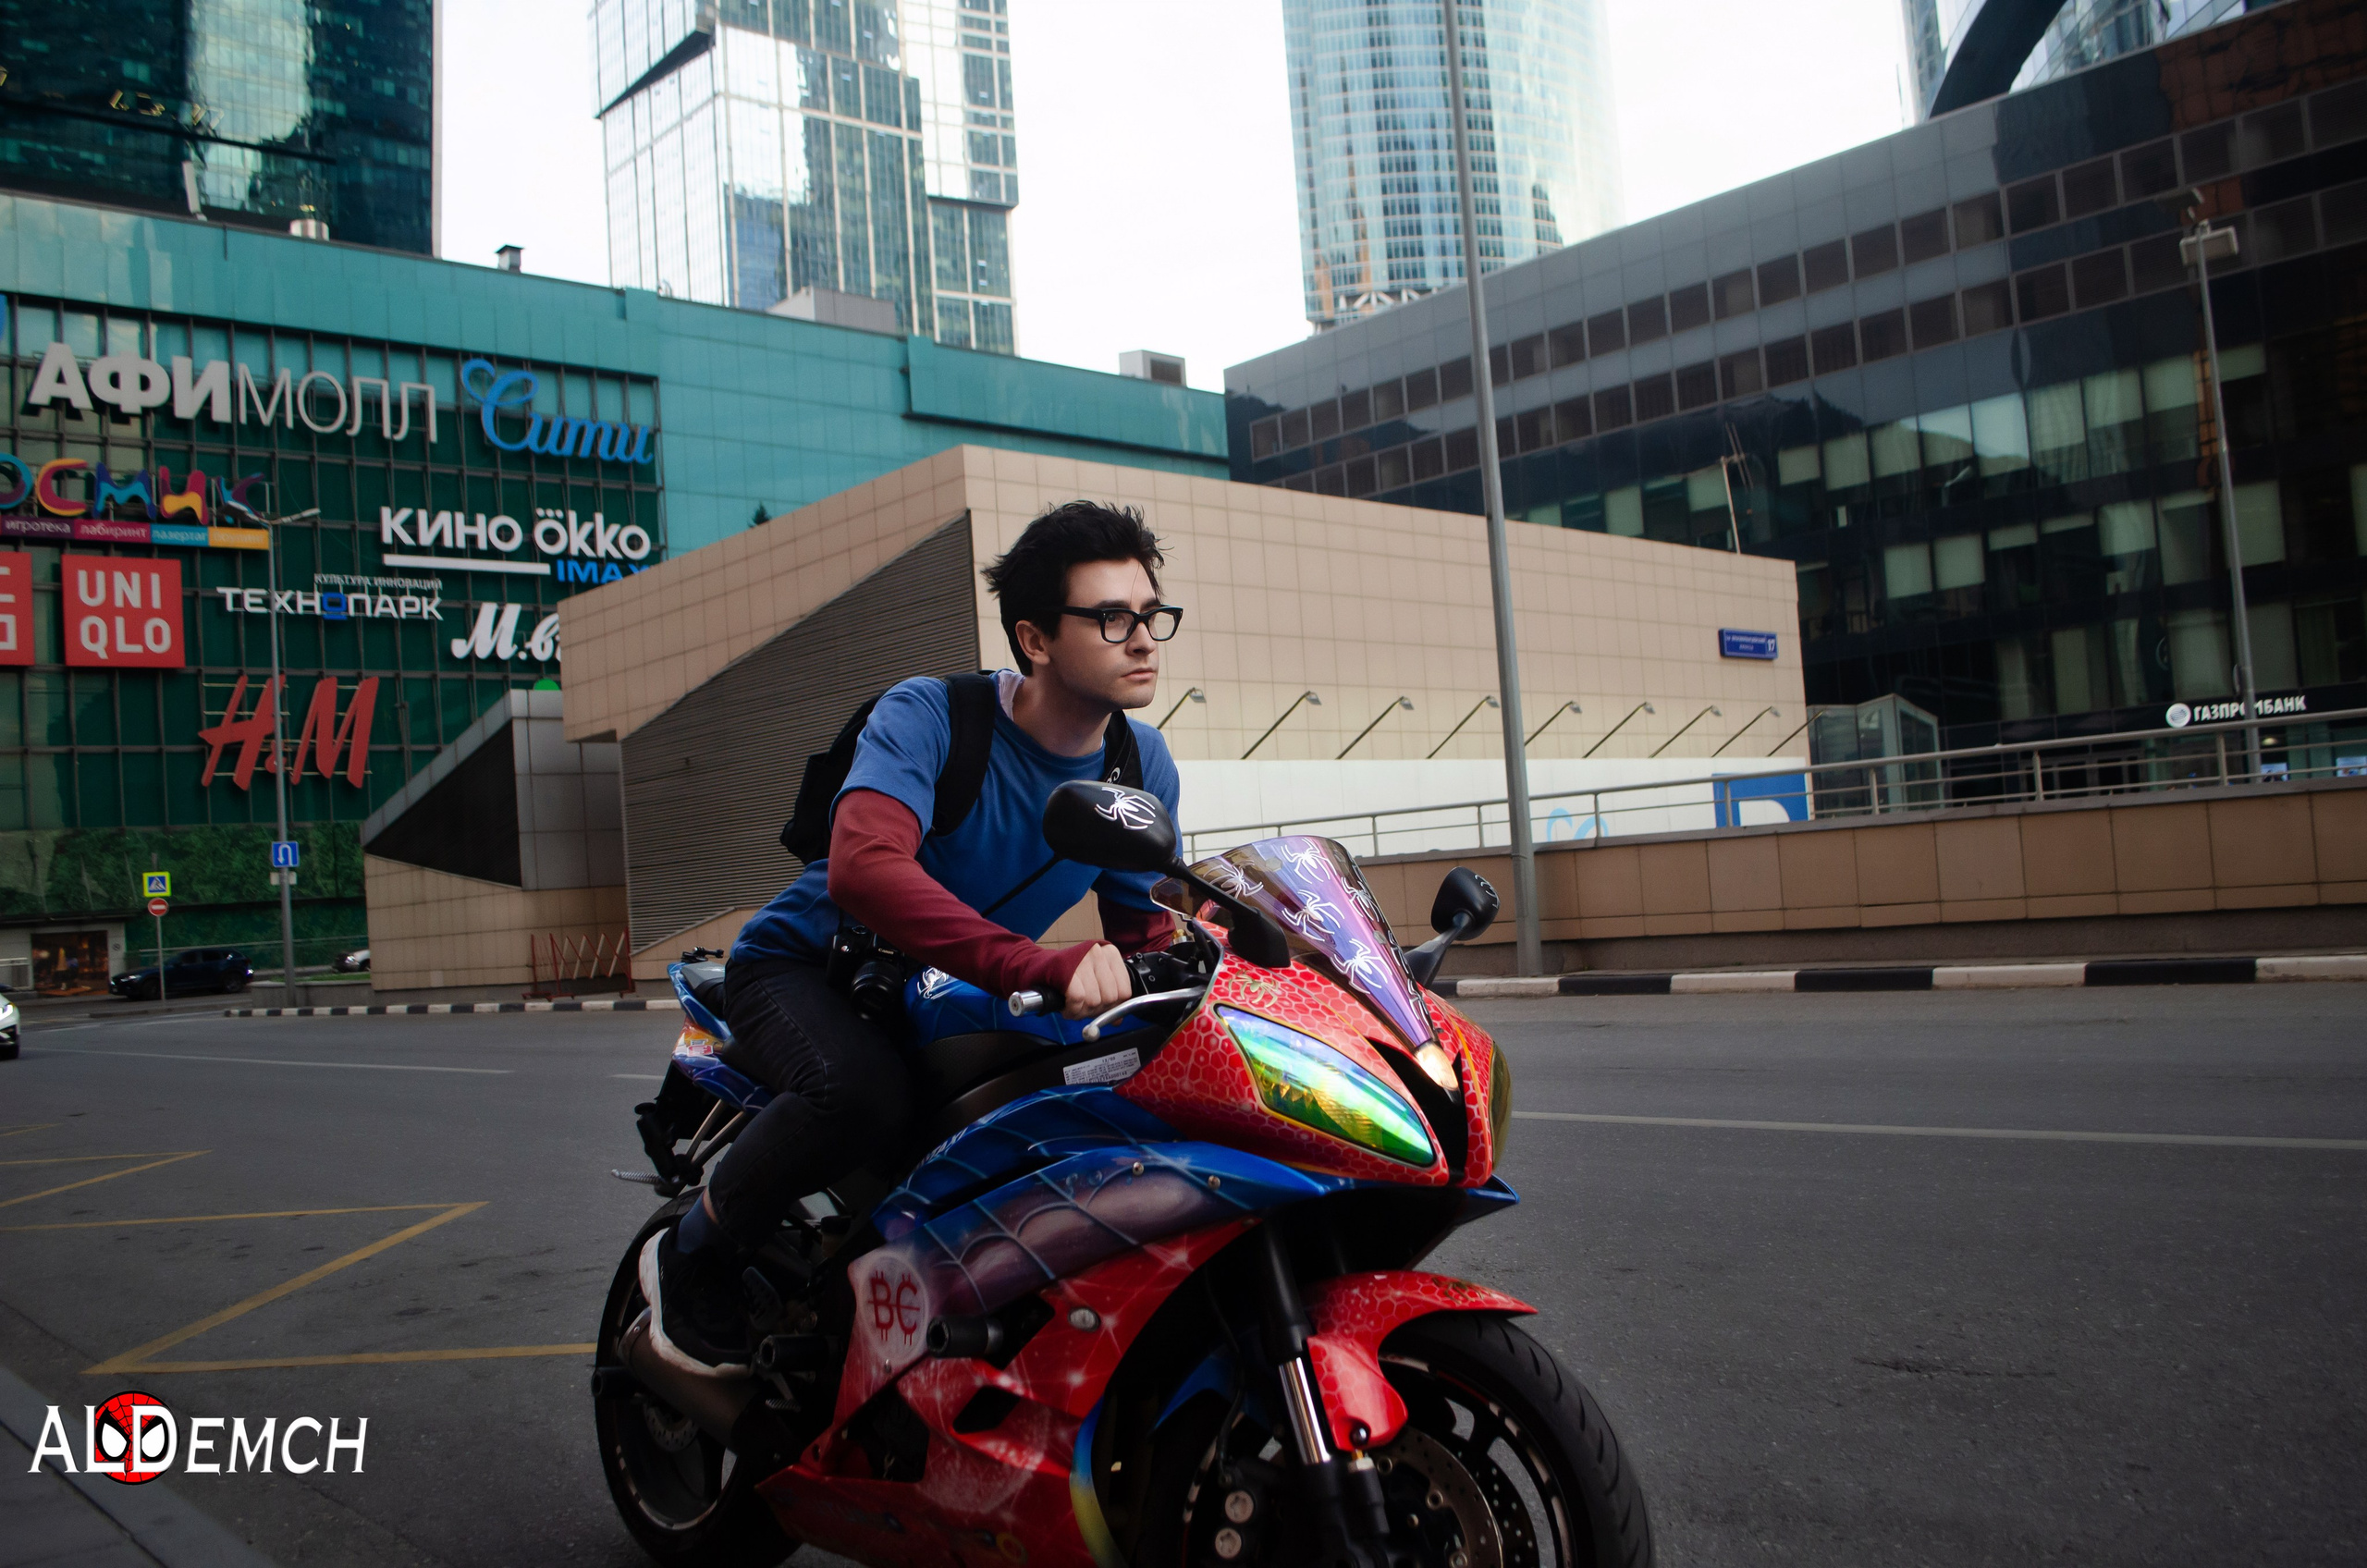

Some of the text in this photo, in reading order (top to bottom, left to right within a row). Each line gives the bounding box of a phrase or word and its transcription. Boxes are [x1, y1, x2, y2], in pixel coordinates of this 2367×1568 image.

[29, 342, 437, 444] АФИМОЛЛ
[380, 506, 523, 552] КИНО
[78, 570, 162, 609] UNI
[314, 573, 443, 591] КУЛЬТУРА ИННОВАЦИЙ
[215, 586, 444, 621] ТЕХНОПАРК
[80, 615, 172, 660] QLO
